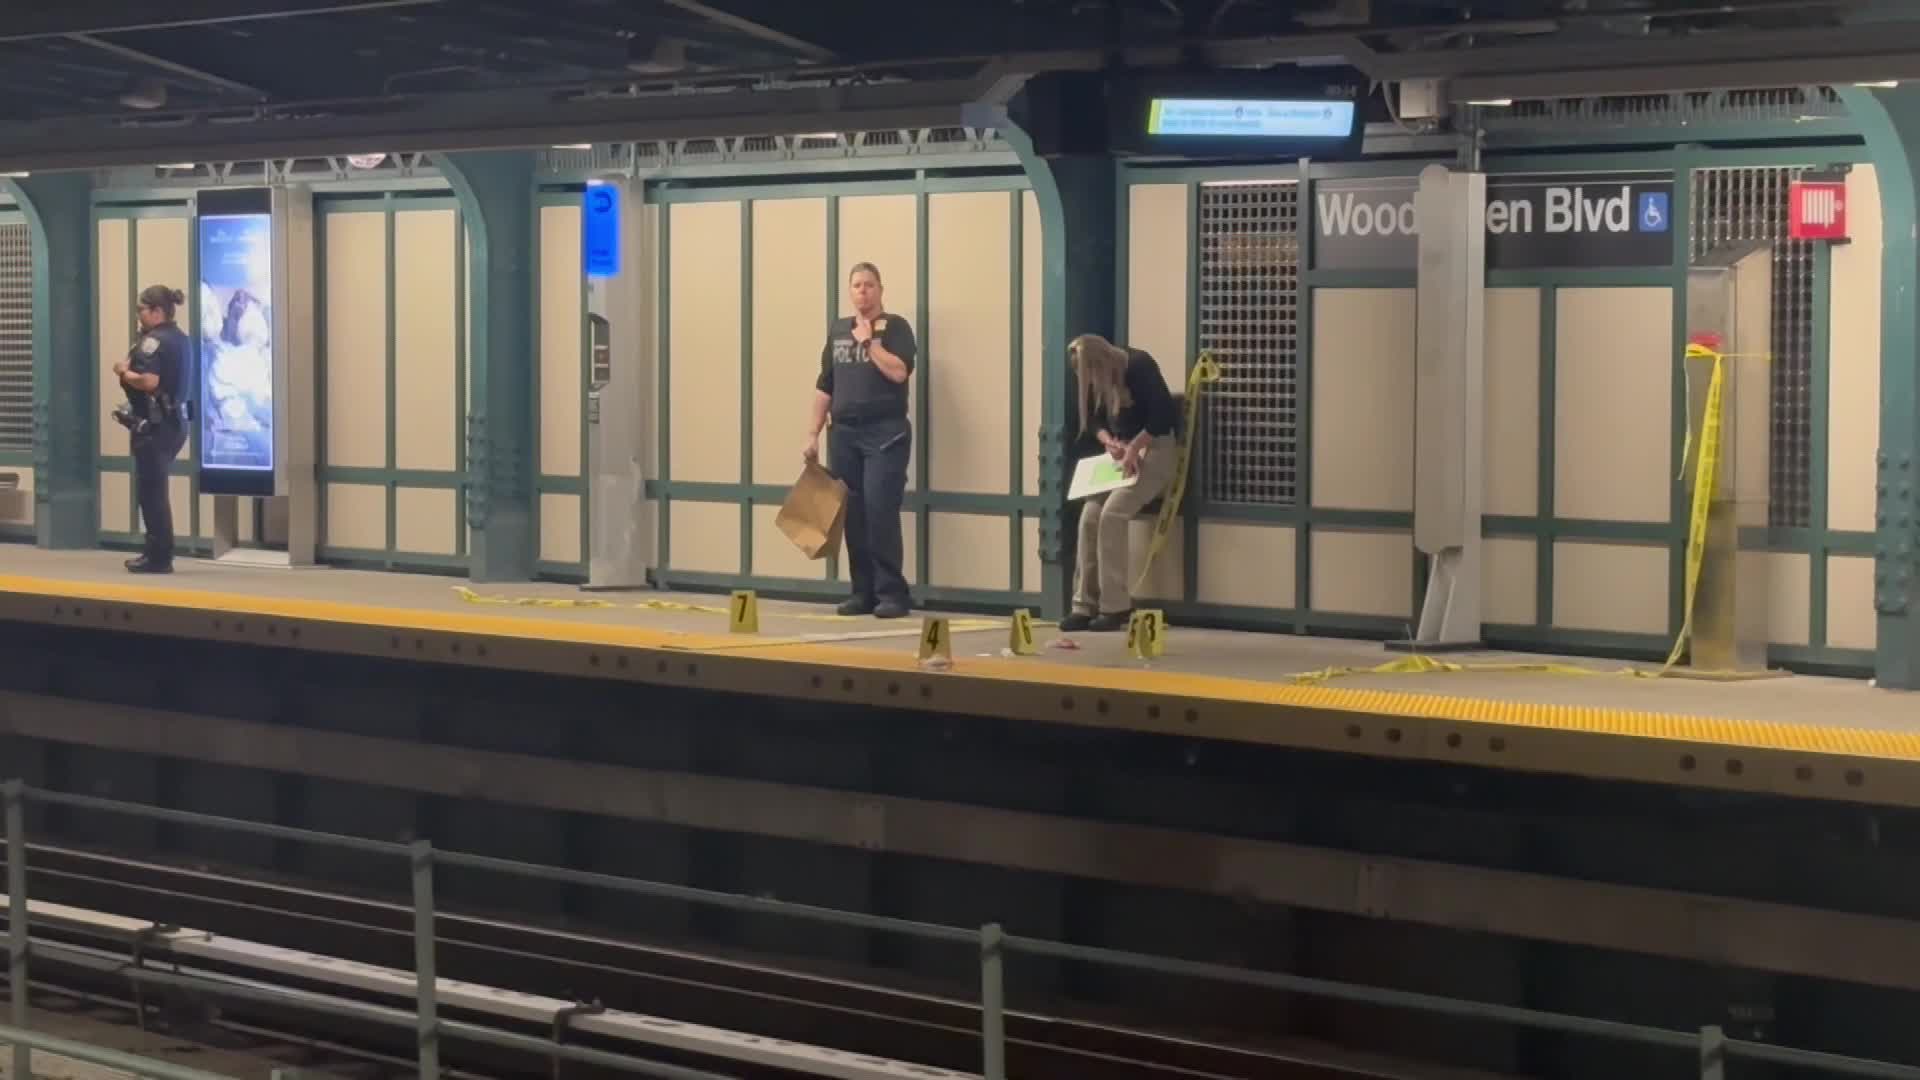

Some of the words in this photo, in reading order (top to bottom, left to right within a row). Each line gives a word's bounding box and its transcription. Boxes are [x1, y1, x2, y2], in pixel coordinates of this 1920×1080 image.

[1318, 191, 1533, 236] Wooden
[1545, 186, 1630, 232] Blvd
[737, 594, 748, 623] 7
[926, 620, 939, 651] 4
[1144, 613, 1155, 642] 3
